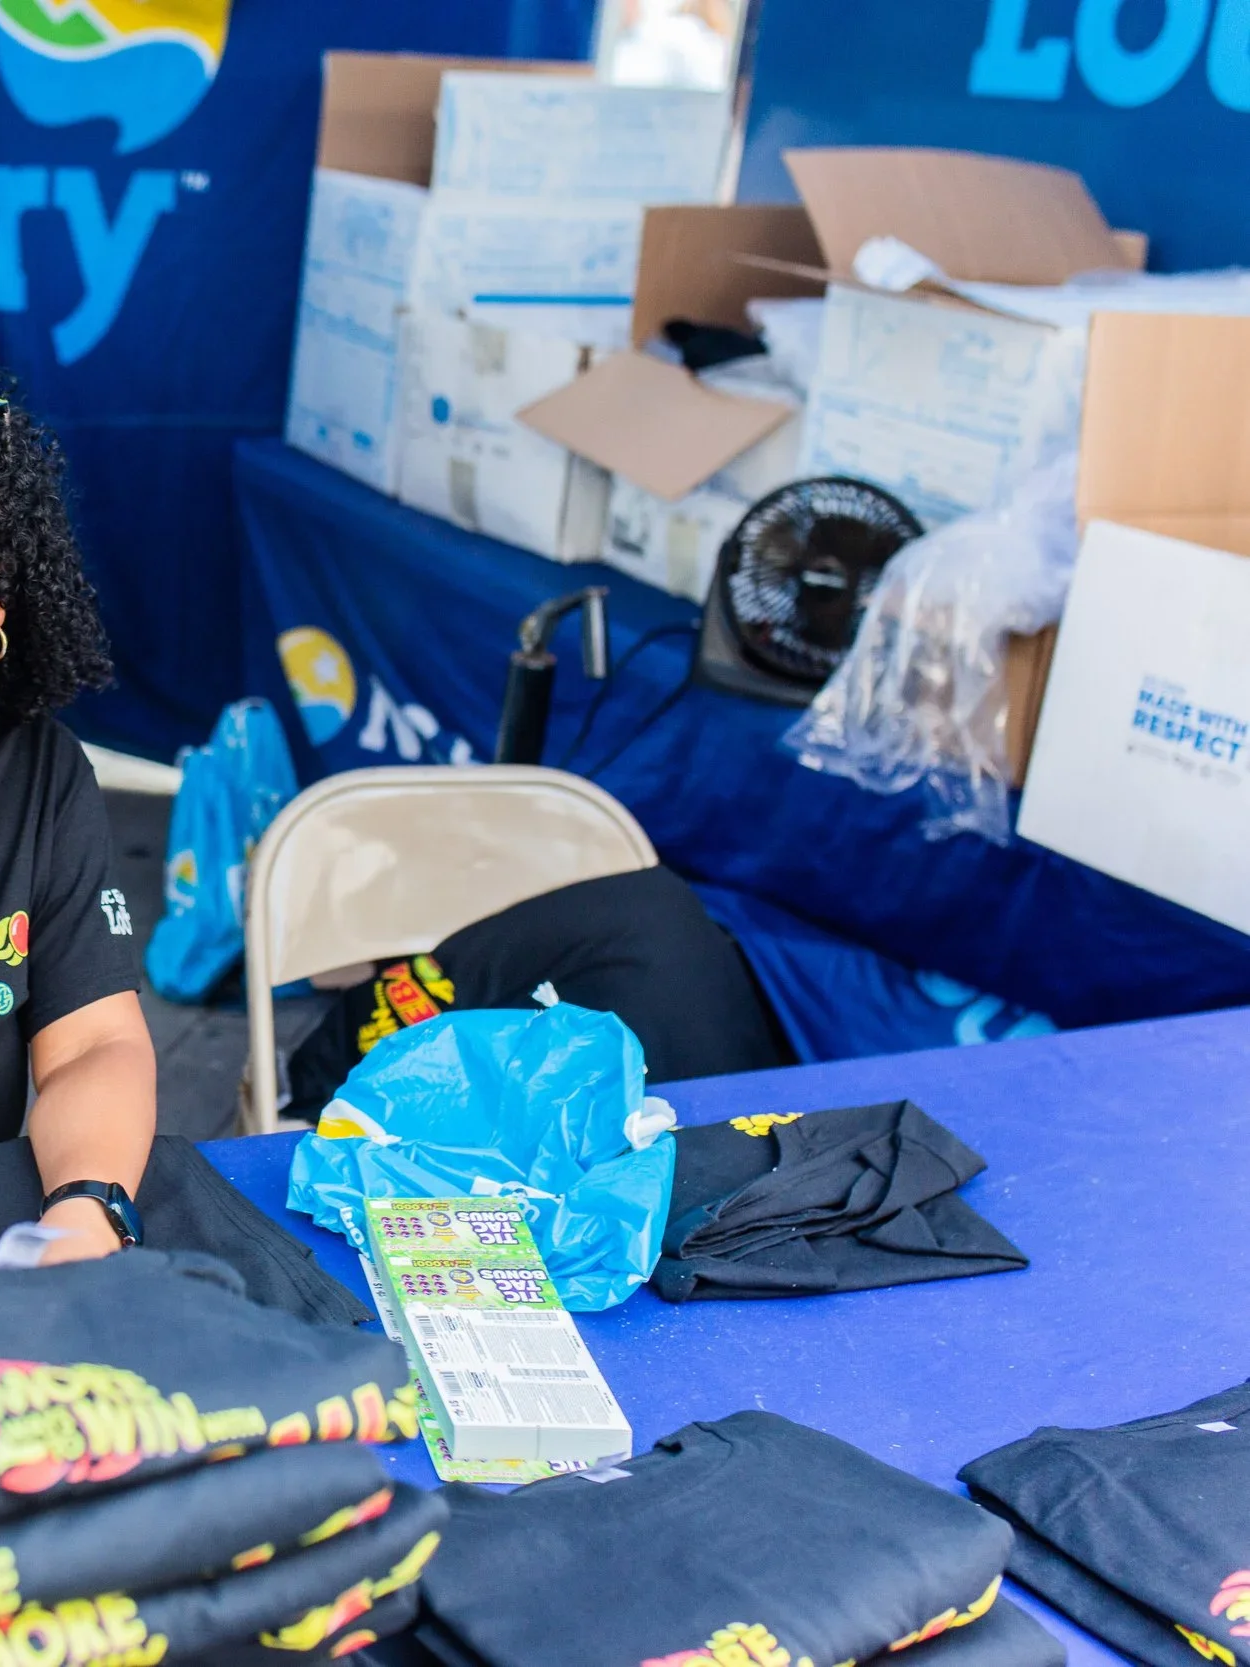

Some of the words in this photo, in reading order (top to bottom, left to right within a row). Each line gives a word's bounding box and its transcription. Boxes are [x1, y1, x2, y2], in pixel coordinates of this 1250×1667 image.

[1198, 708, 1248, 738] WITH
[1132, 708, 1242, 764] RESPECT
[455, 1211, 523, 1222] BONUS
[472, 1221, 517, 1233] TAC
[479, 1232, 520, 1245] TIC
[478, 1268, 549, 1280] BONUS
[495, 1279, 542, 1292] TAC
[503, 1290, 546, 1303] TIC
